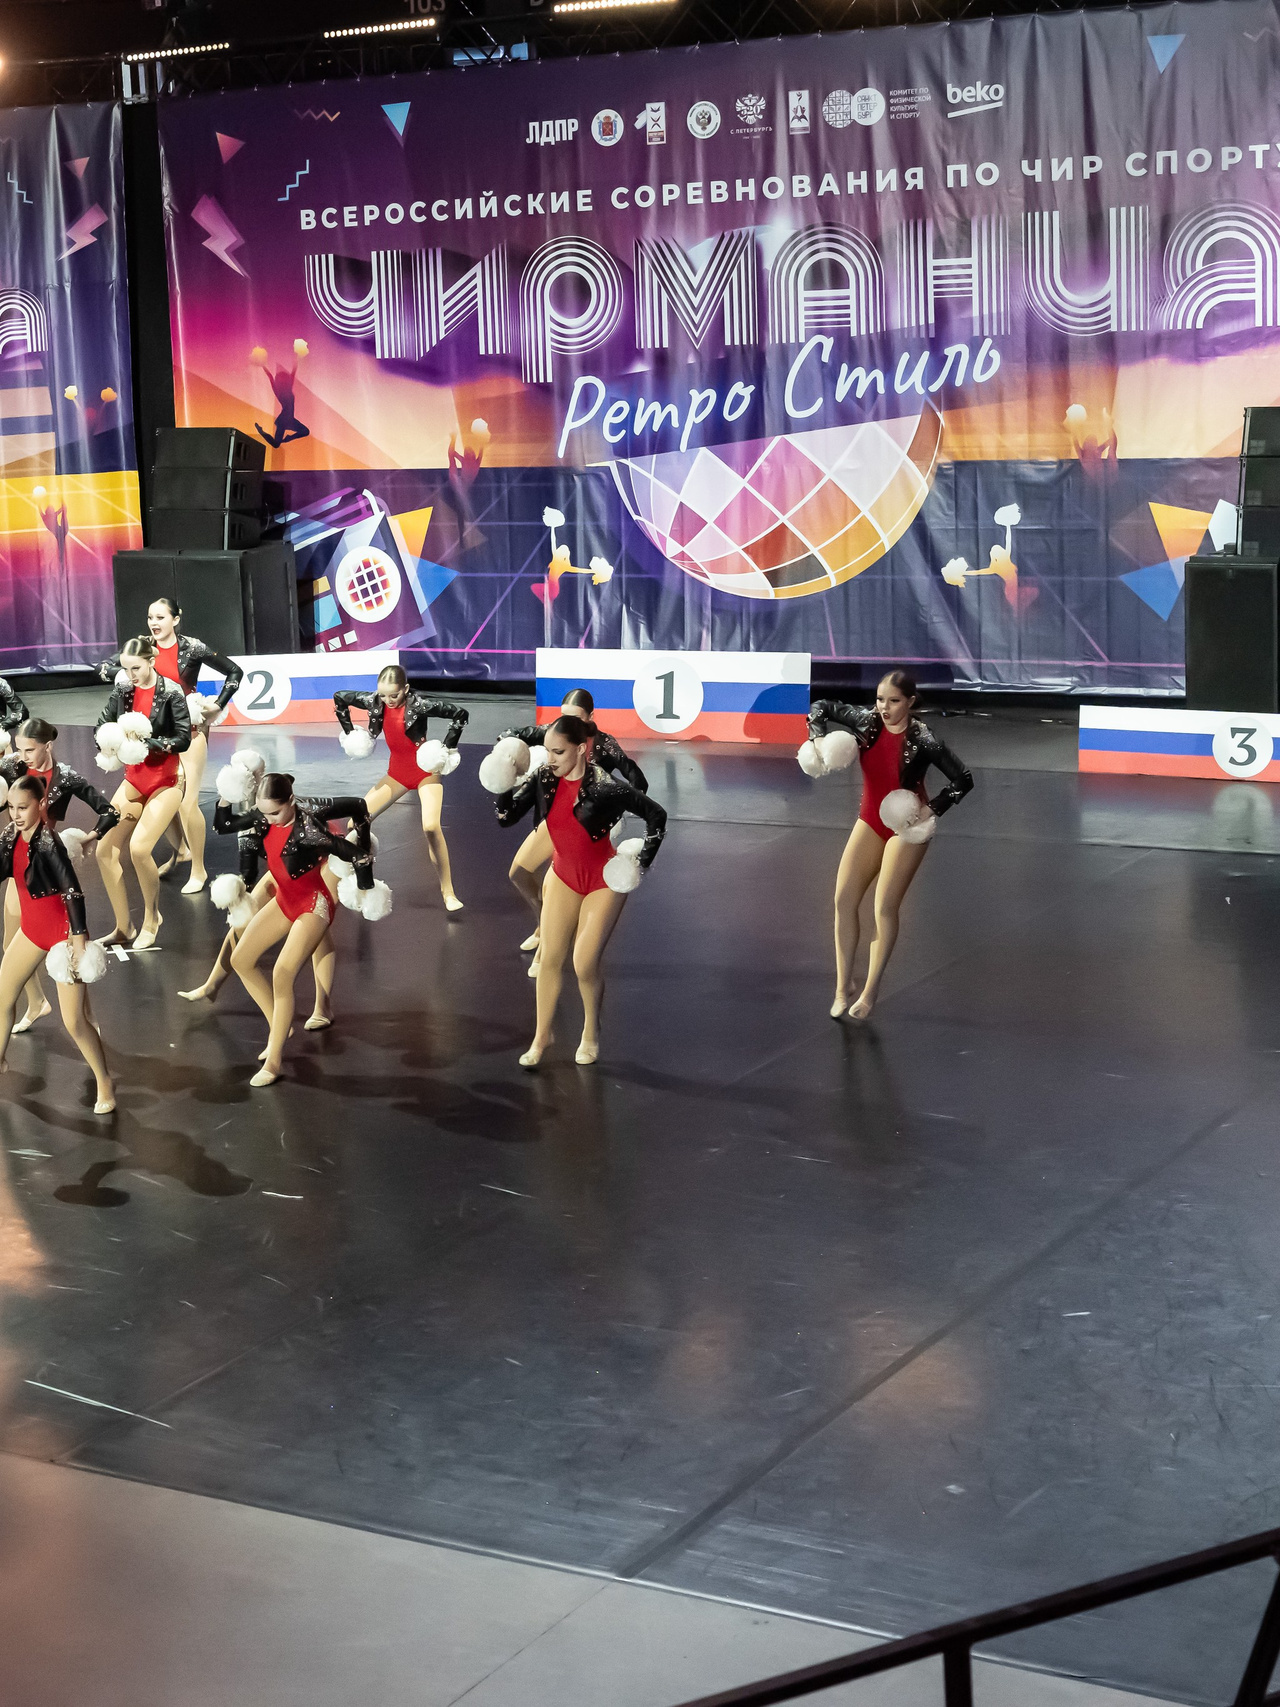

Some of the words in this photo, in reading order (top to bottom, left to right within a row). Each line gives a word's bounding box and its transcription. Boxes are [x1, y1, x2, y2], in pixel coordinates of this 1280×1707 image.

[889, 88, 918, 96] КОМИТЕТ
[889, 94, 932, 104] ФИЗИЧЕСКОЙ
[946, 80, 1004, 104] beko
[890, 104, 919, 112] КУЛЬТУРЕ
[895, 112, 921, 120] СПОРТУ
[526, 118, 579, 146] ЛДПР
[300, 189, 594, 230] ВСЕРОССИЙСКИЕ
[610, 167, 925, 210] СОРЕВНОВАНИЯ
[947, 162, 1000, 188] ПО
[1021, 155, 1104, 183] ЧИР
[1125, 143, 1280, 177] СПОРТ
[557, 375, 755, 459] Ретро
[784, 334, 1002, 418] Стиль
[247, 670, 276, 710] 2
[655, 671, 680, 719] 1
[1229, 727, 1257, 766] 3
